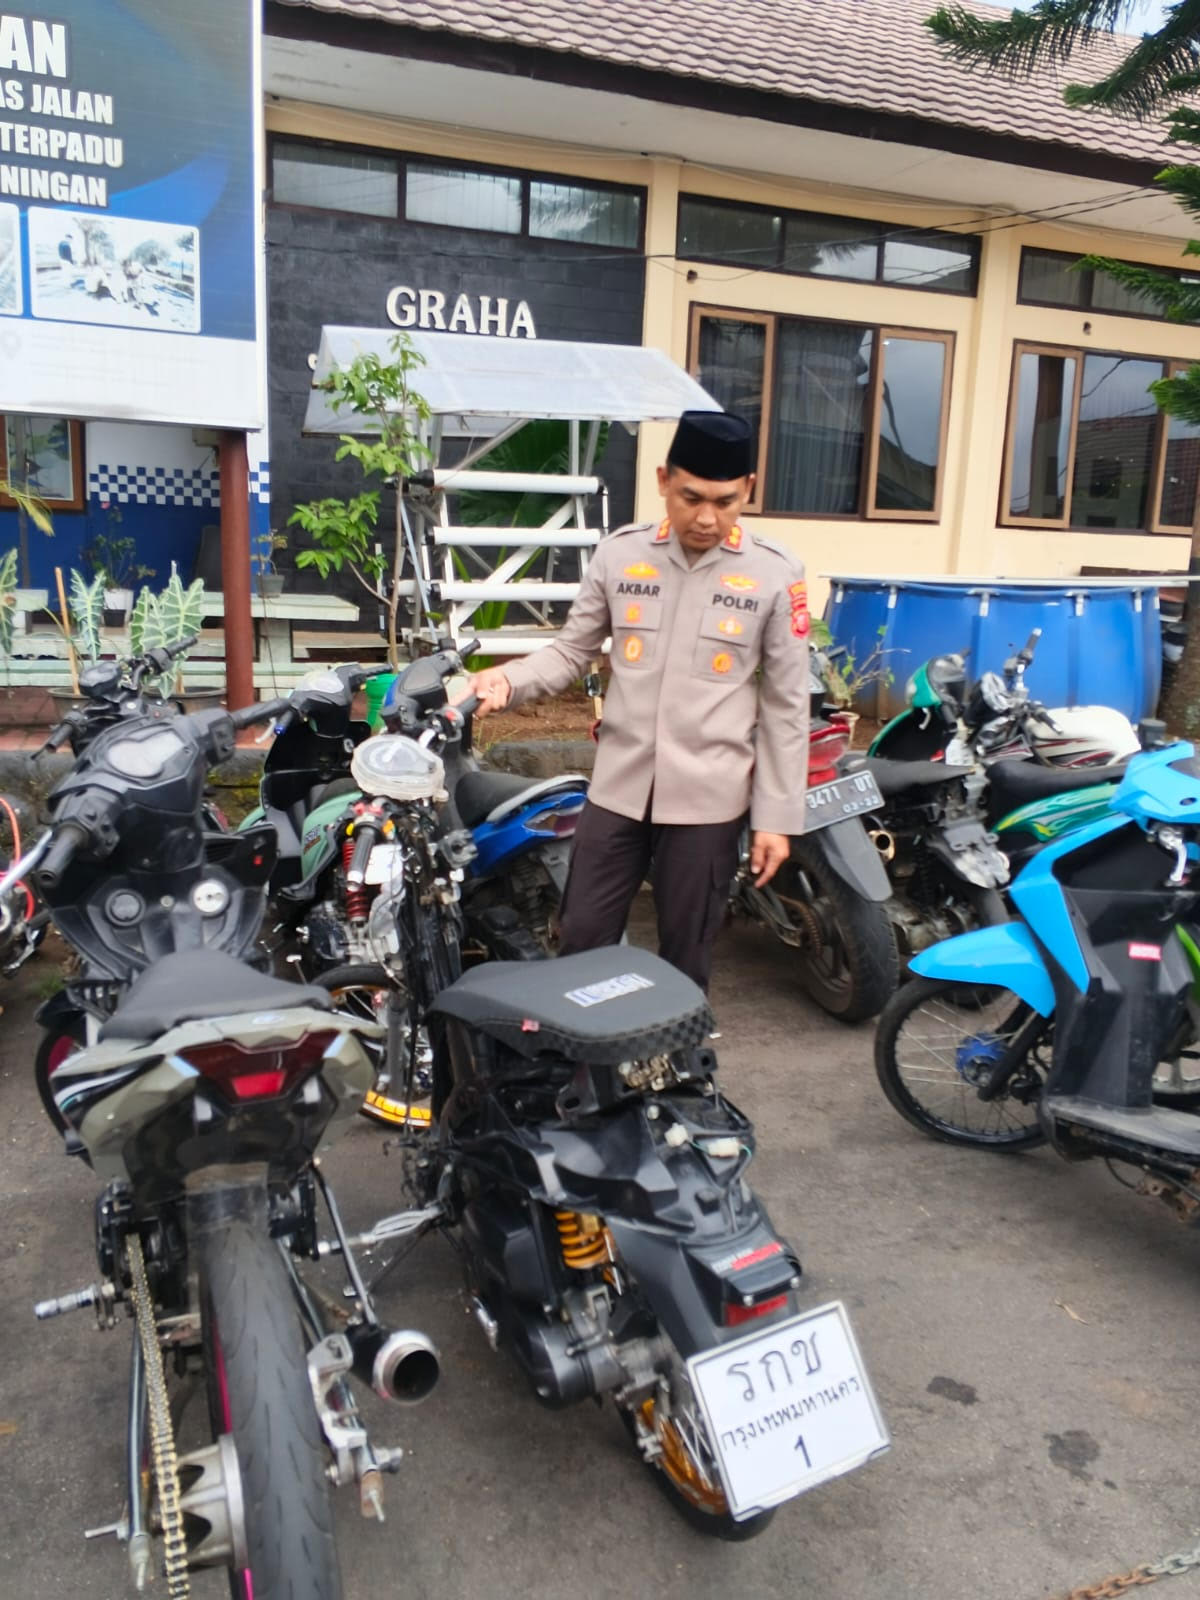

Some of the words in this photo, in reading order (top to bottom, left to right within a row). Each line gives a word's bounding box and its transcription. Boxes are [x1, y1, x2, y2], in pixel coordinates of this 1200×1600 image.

[0, 15, 67, 78] AN
[30, 84, 113, 124] JALAN
[0, 121, 123, 168] TERPADU
[0, 165, 107, 207] NINGAN
[386, 285, 536, 339] GRAHA
[616, 582, 660, 597] AKBAR
[712, 594, 759, 613] POLRI
[794, 1434, 812, 1468] 1
